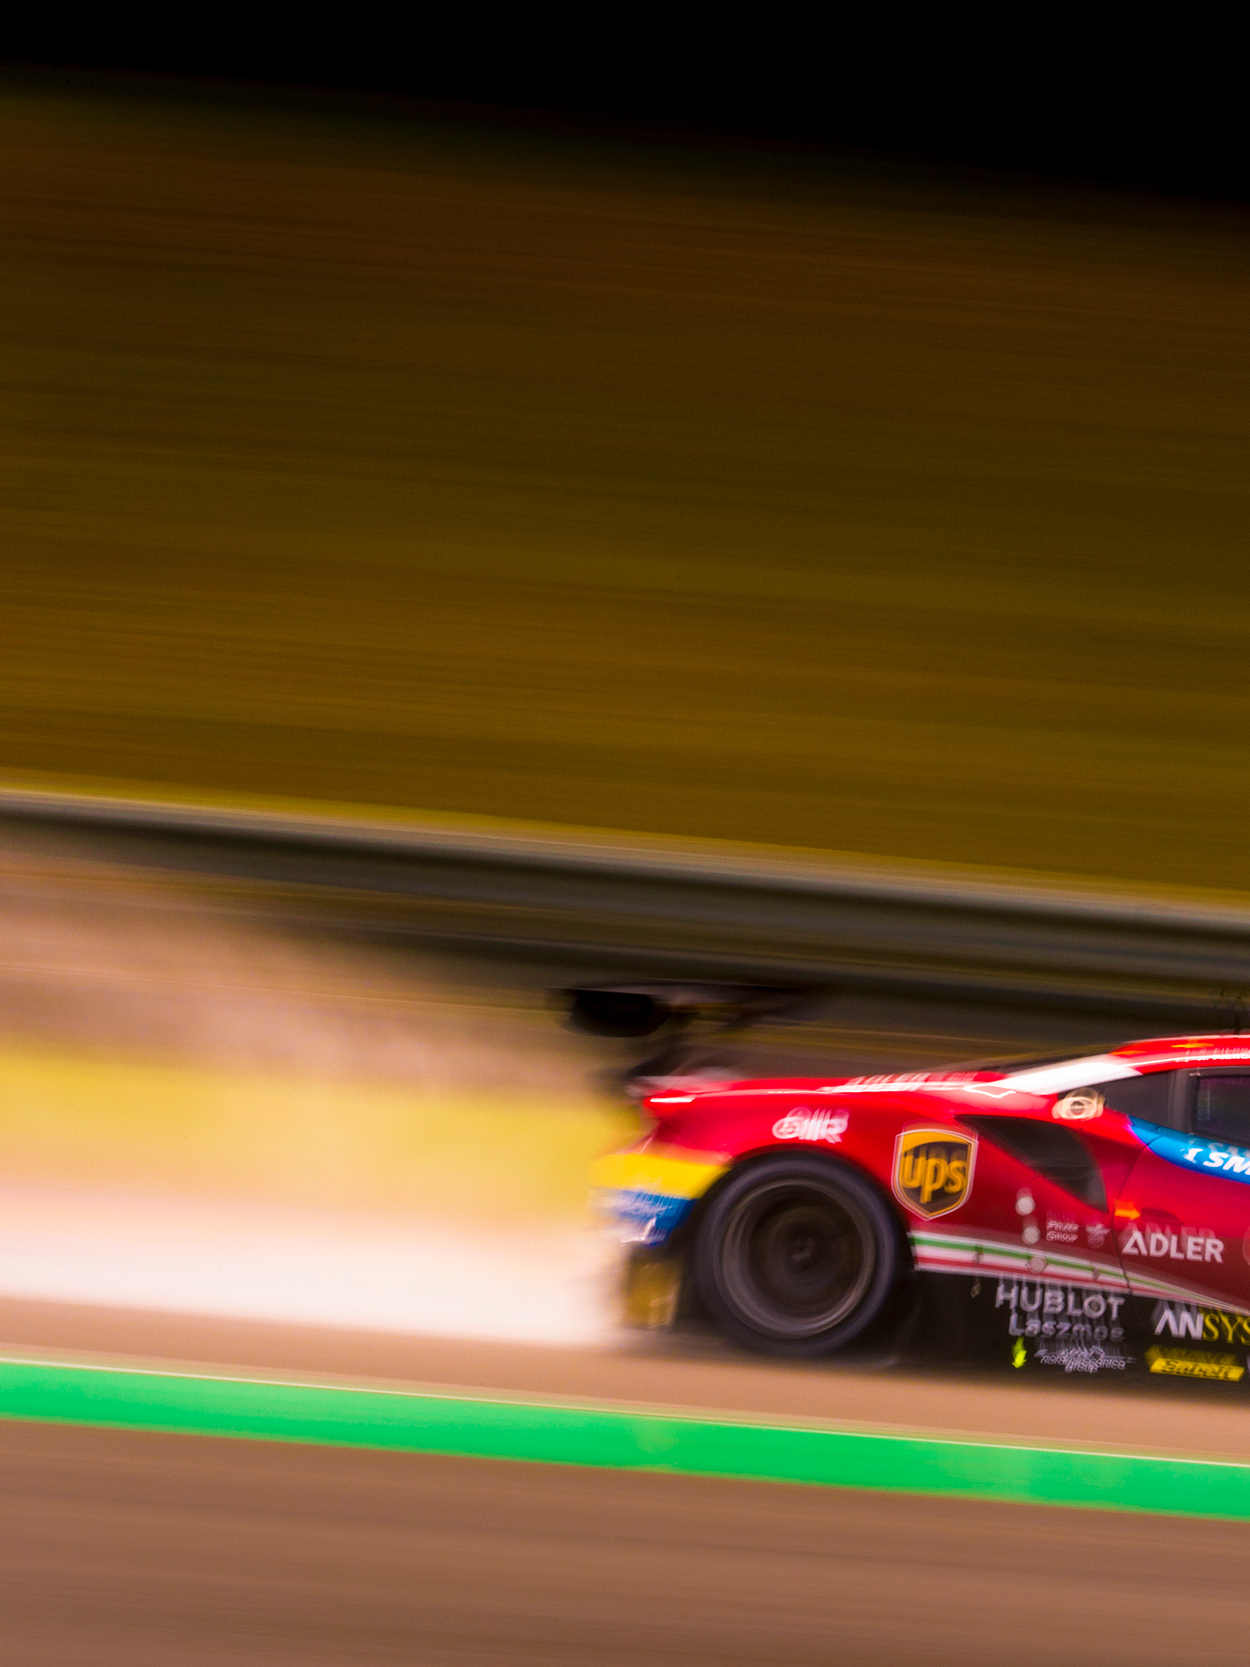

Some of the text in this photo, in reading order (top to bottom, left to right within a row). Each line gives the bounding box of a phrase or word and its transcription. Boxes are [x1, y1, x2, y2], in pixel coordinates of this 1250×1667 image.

[903, 1155, 968, 1204] ups
[1121, 1230, 1225, 1264] ADLER
[995, 1284, 1126, 1320] HUBLOT
